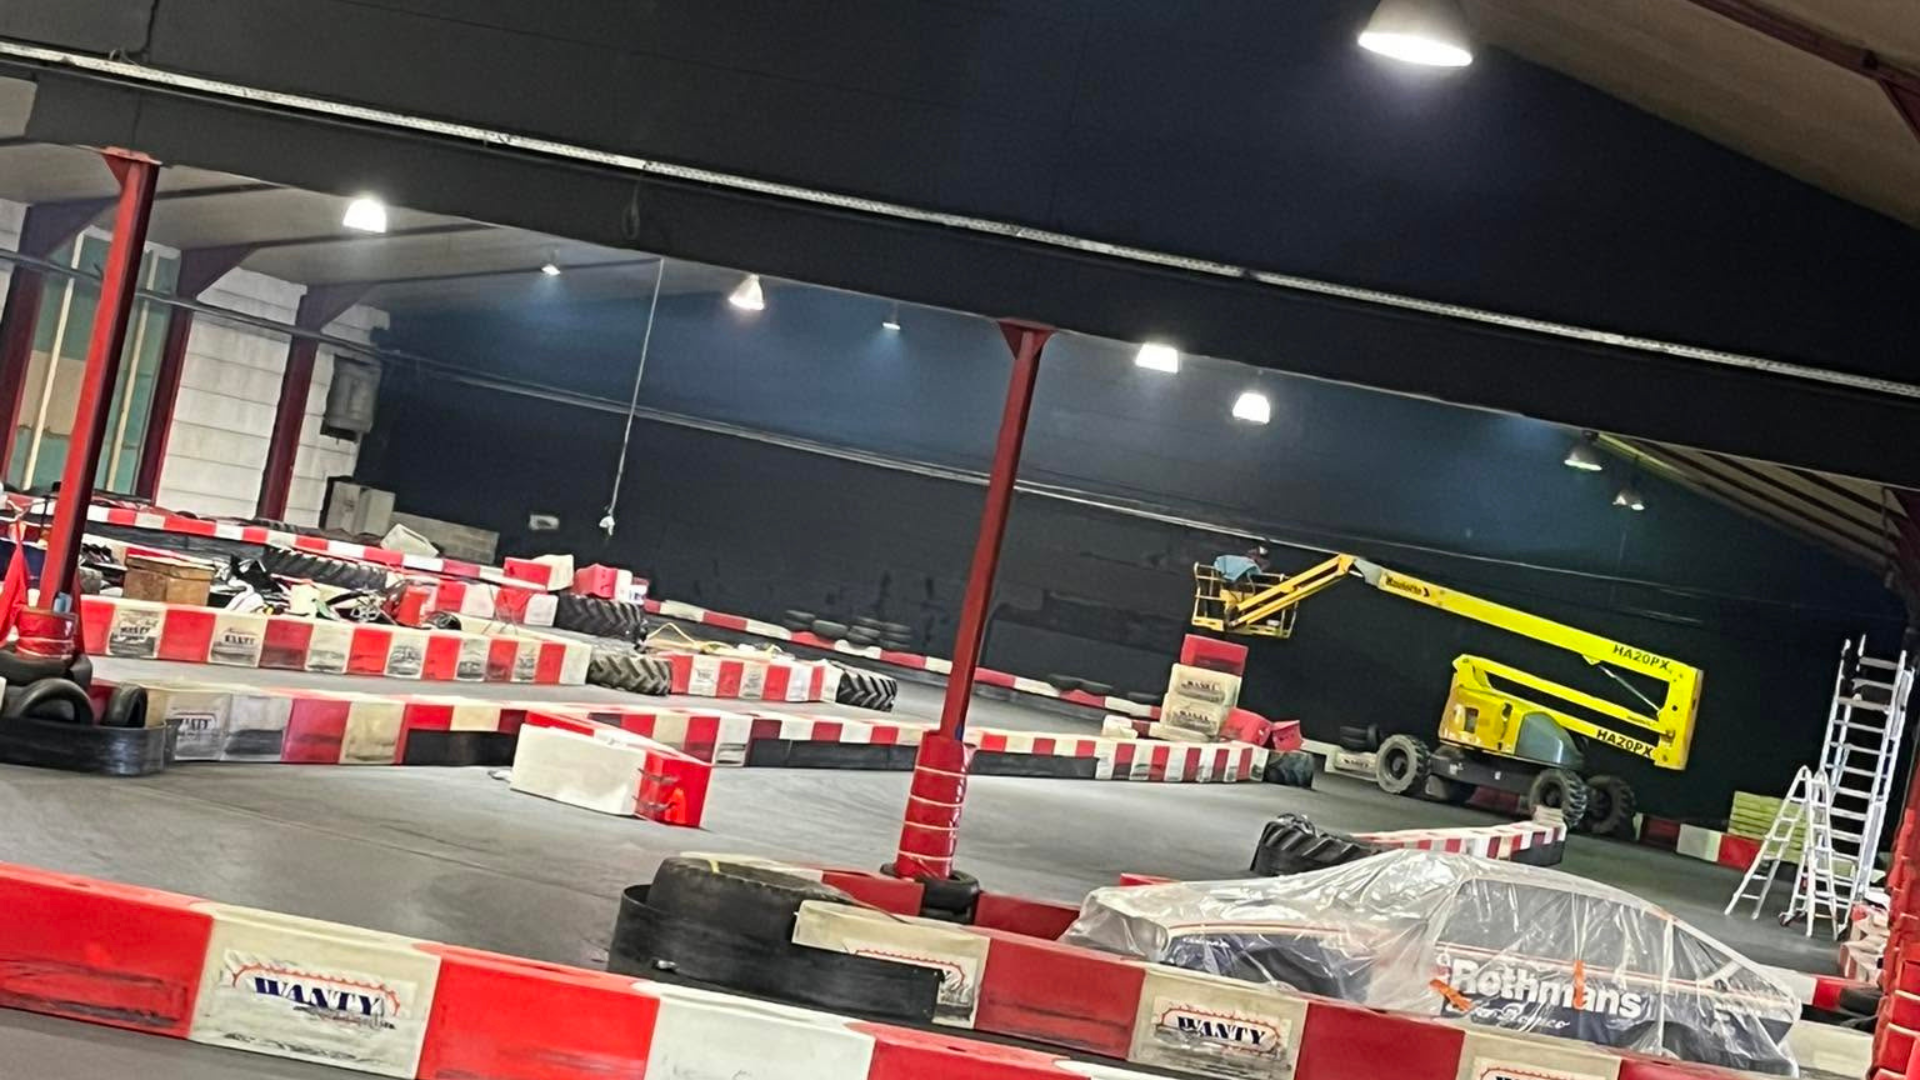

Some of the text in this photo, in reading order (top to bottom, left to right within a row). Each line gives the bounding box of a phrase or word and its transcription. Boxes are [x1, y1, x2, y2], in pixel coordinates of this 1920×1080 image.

[1612, 644, 1670, 670] HA20PX
[1596, 729, 1654, 757] HA20PX
[252, 976, 382, 1016] WANTY
[1450, 958, 1643, 1019] Rothmans
[1177, 1015, 1266, 1045] WANTY
